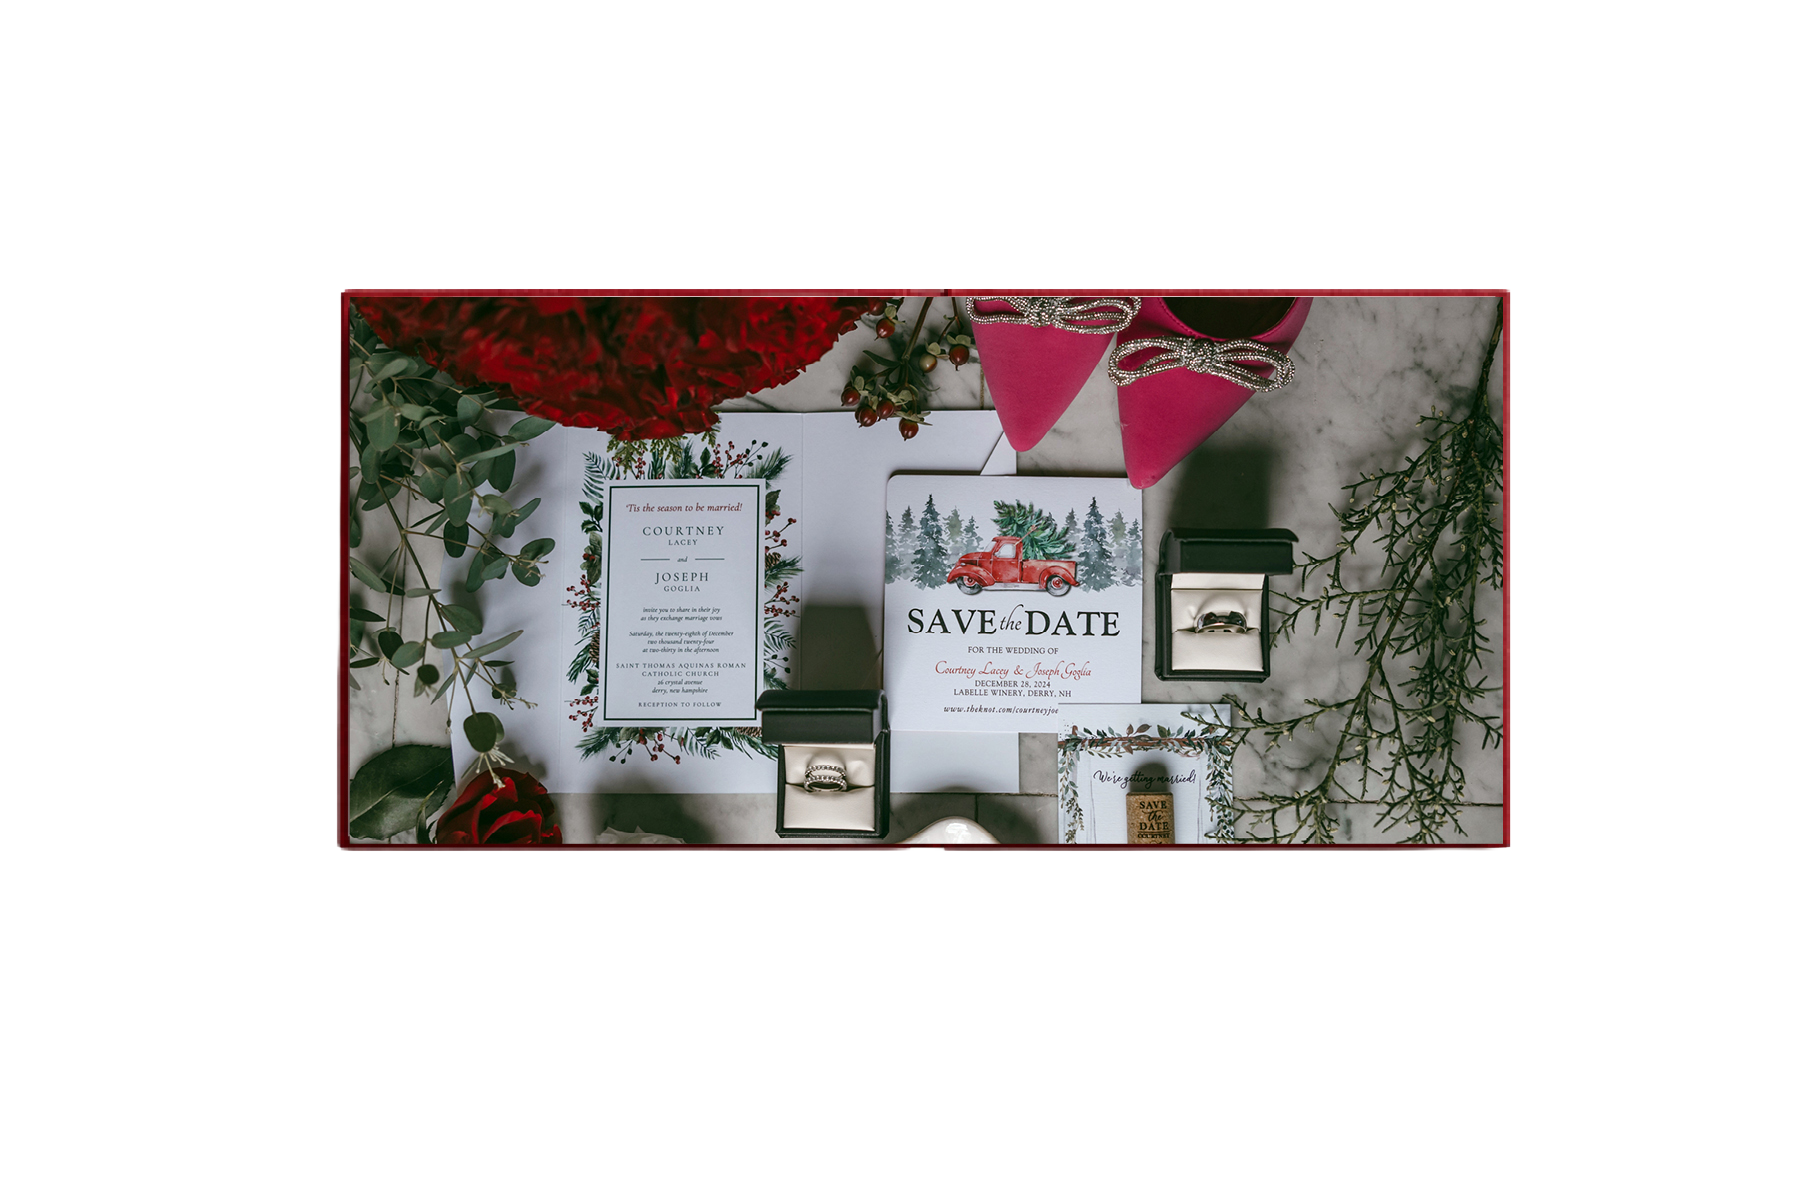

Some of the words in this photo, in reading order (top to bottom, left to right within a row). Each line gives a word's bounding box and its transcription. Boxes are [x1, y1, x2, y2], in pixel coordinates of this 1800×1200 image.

[642, 503, 654, 512] the
[696, 502, 704, 512] be
[707, 502, 742, 512] married!
[642, 526, 724, 536] COURTNEY
[654, 572, 708, 584] JOSEPH
[907, 608, 997, 634] SAVE
[1000, 604, 1024, 630] the
[1025, 610, 1120, 636] DATE
[935, 660, 976, 679] Courtney
[978, 661, 1009, 679] Lacey
[1014, 665, 1024, 676] &
[1026, 660, 1064, 680] Joseph
[1060, 661, 1092, 680] Goglia
[1093, 770, 1122, 783] We're
[1120, 770, 1154, 789] getting
[1157, 770, 1196, 783] married!
[1140, 800, 1167, 809] SAVE
[1140, 822, 1168, 830] DATE
